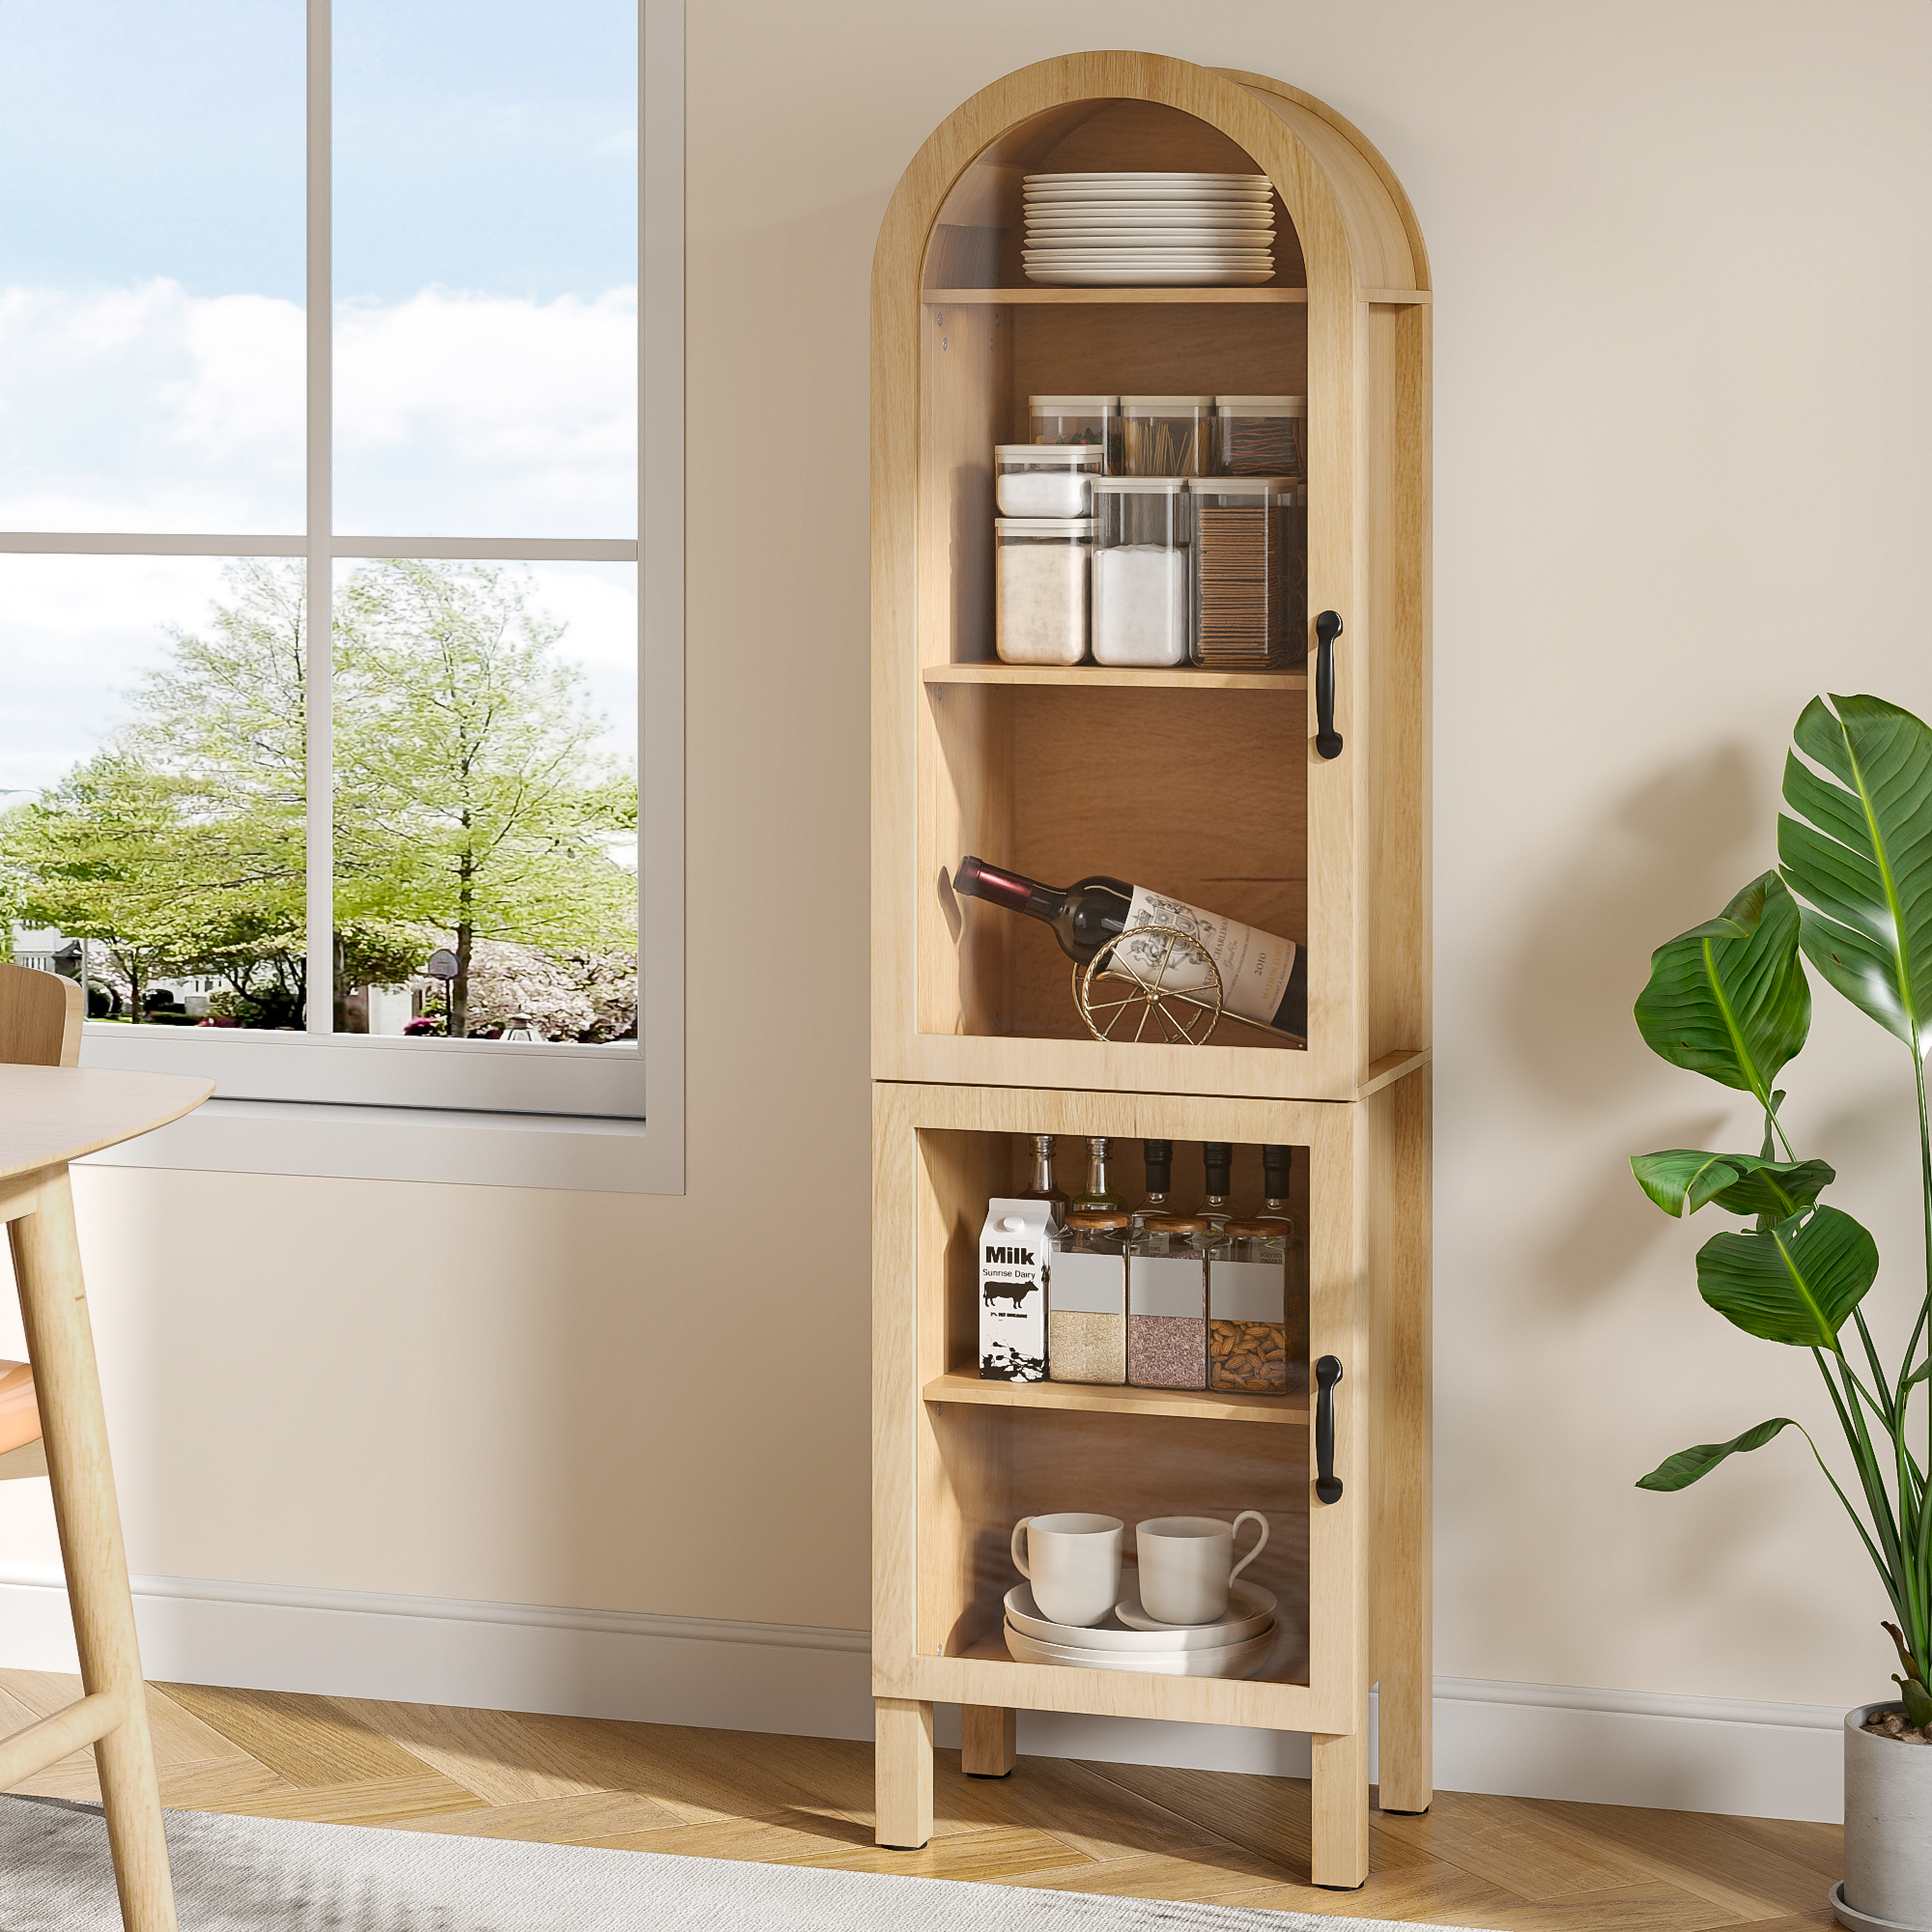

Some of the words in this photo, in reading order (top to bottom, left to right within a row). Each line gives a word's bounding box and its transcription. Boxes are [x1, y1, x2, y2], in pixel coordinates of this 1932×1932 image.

[1255, 952, 1266, 977] 2010
[1262, 967, 1277, 1000] MAISON
[985, 1246, 1036, 1265] Milk
[1014, 1270, 1036, 1279] Dairy
